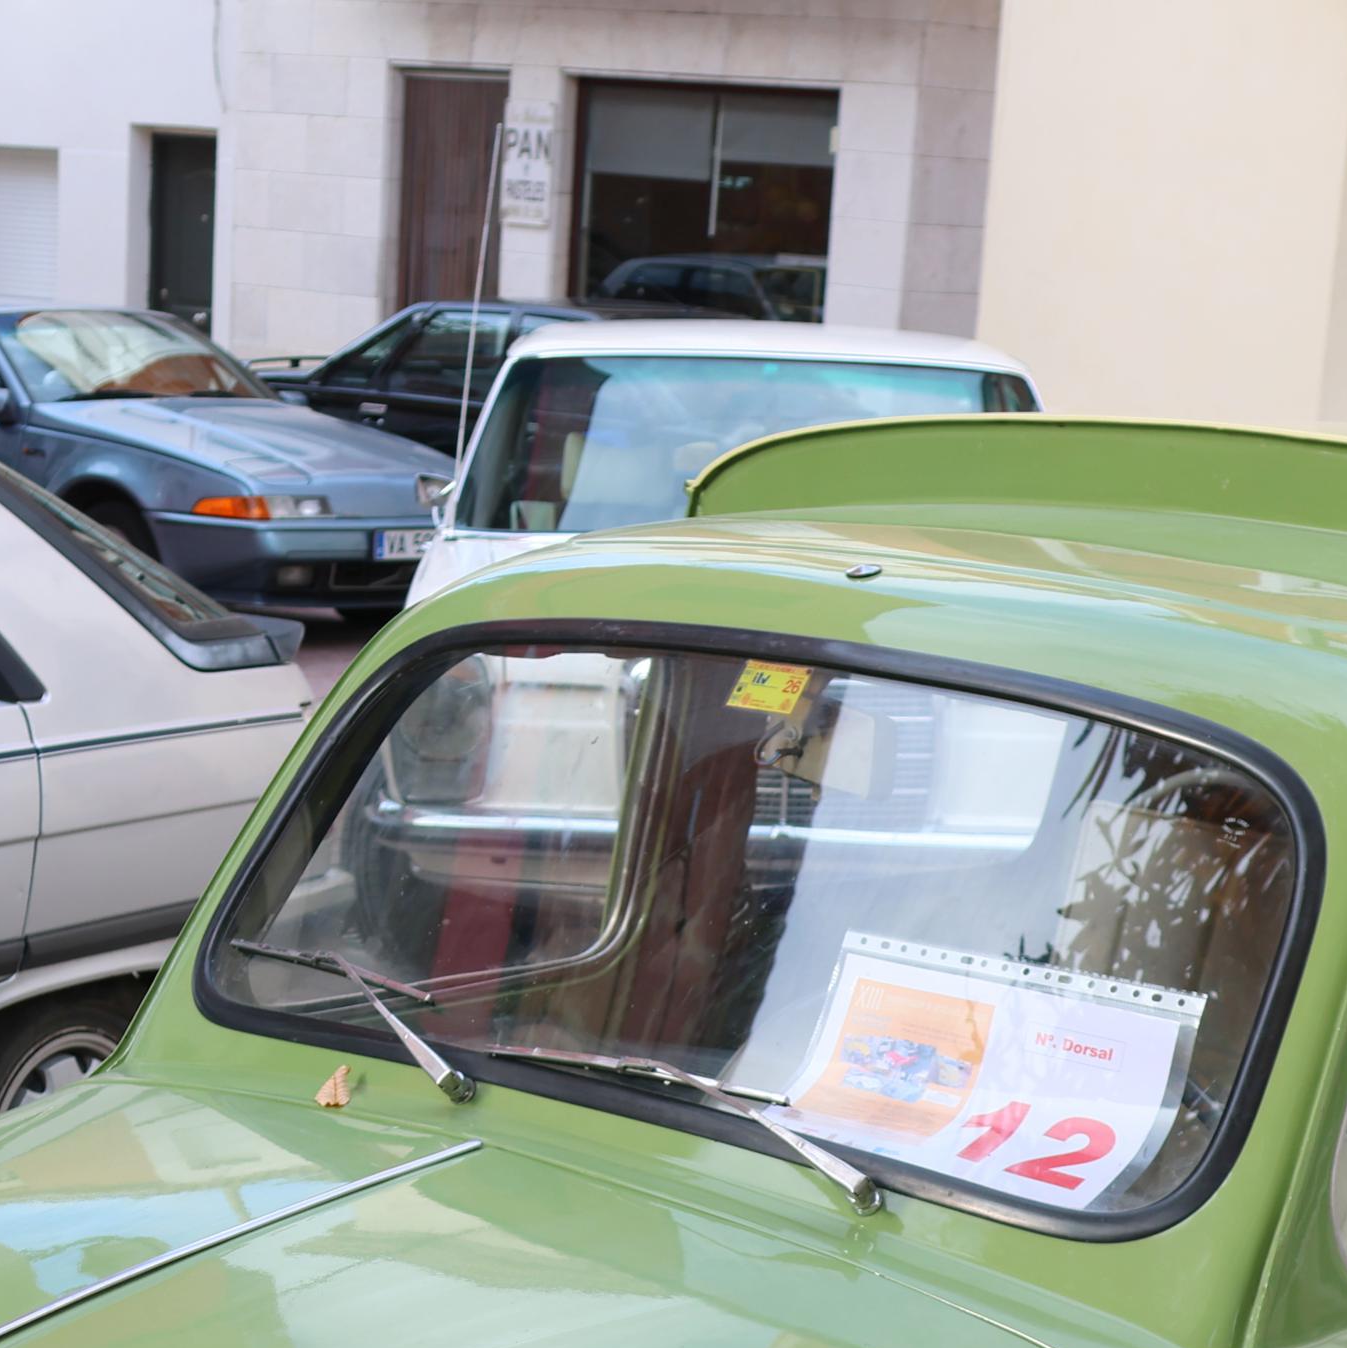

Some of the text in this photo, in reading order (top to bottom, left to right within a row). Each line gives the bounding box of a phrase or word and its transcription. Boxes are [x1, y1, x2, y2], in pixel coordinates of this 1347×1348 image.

[506, 127, 551, 161] PAN
[781, 680, 802, 694] 26
[1062, 1038, 1114, 1061] Dorsal
[956, 1101, 1116, 1191] 12
